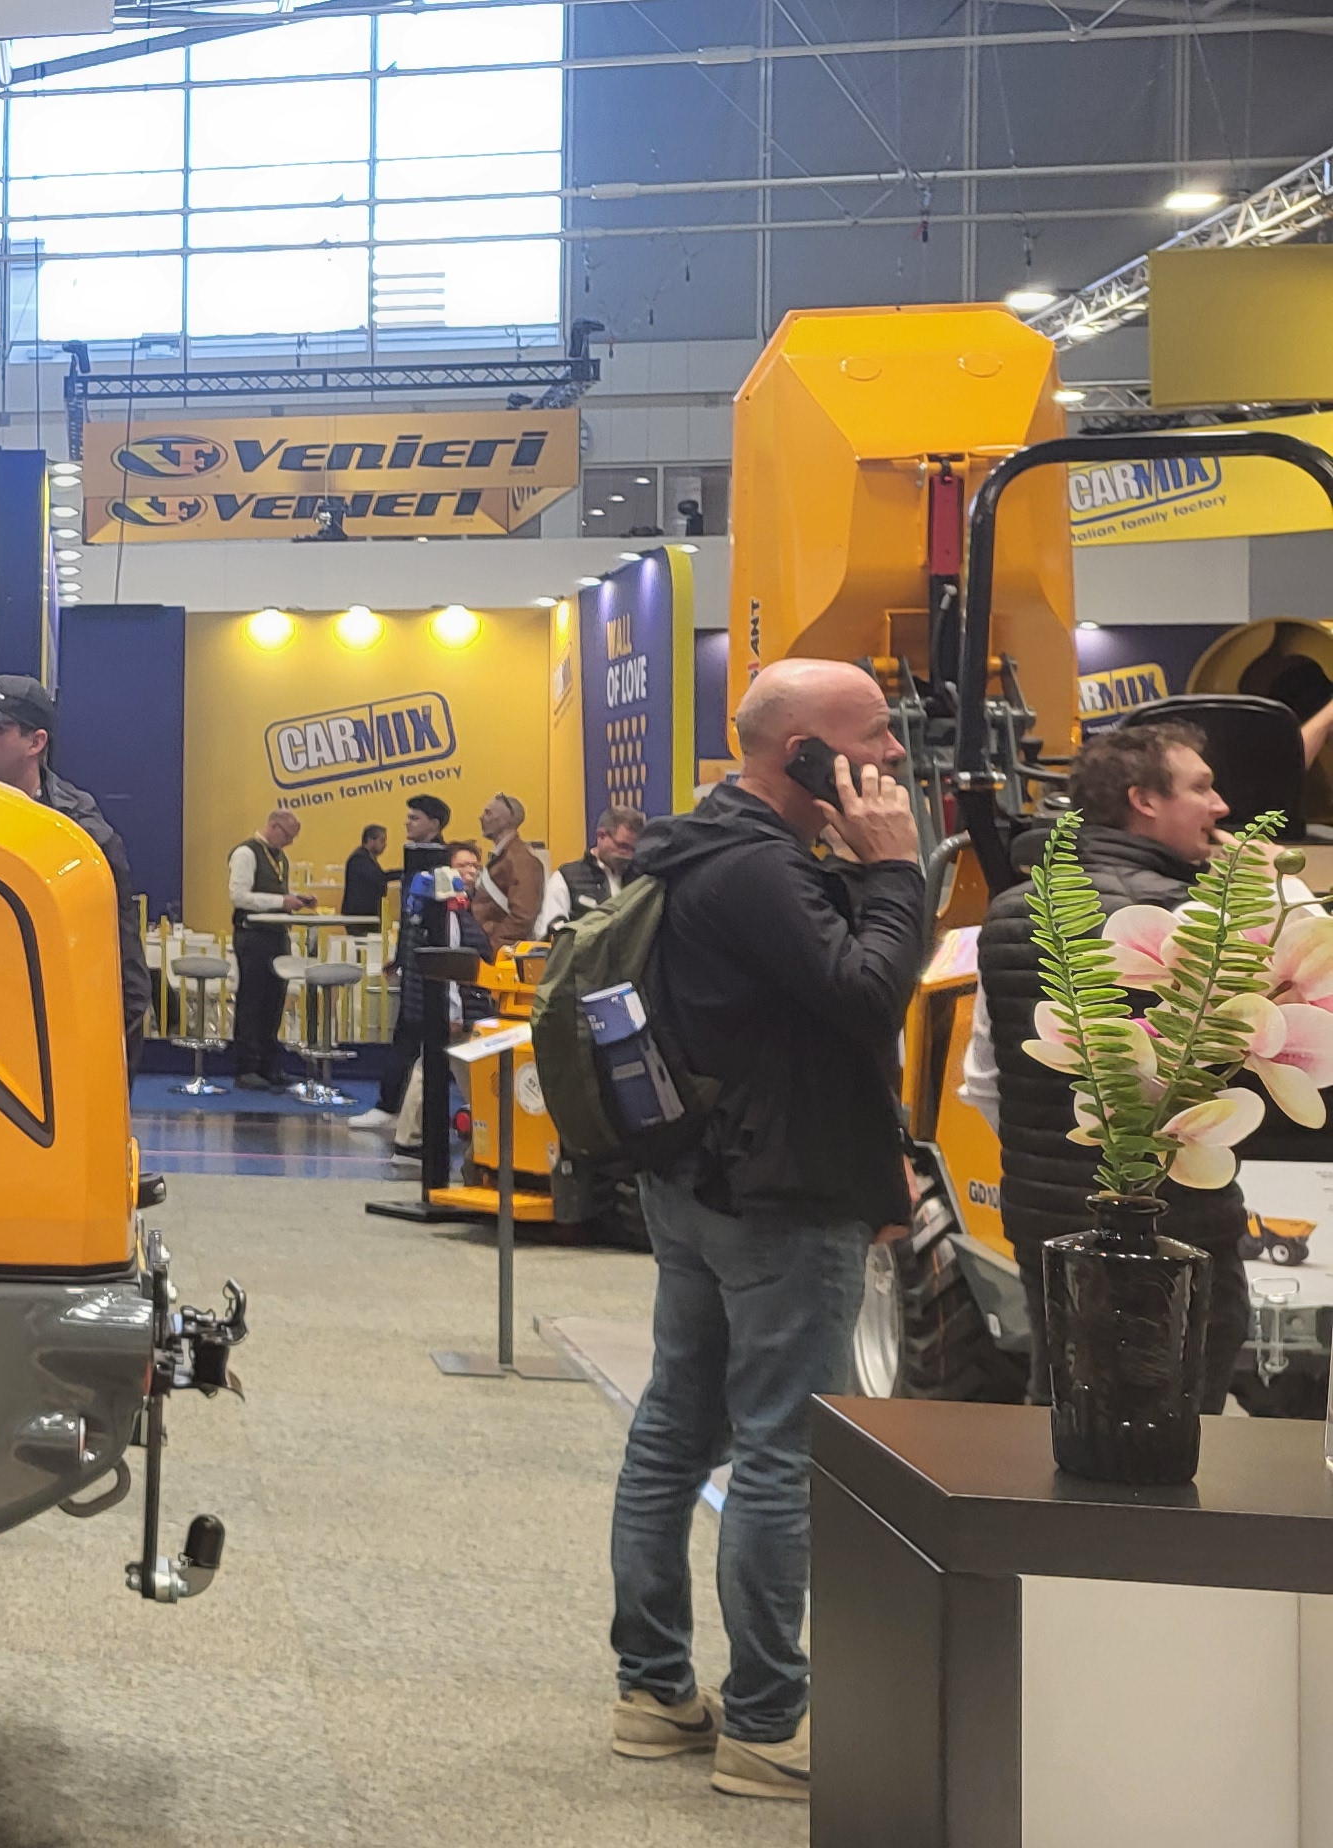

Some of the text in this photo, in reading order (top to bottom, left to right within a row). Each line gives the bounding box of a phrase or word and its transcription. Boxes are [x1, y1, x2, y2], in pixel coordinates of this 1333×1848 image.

[1069, 457, 1210, 513] CARMIX
[1121, 510, 1168, 531] family
[1173, 494, 1228, 517] factory
[606, 664, 620, 709] OF
[621, 654, 648, 705] LOVE
[277, 704, 443, 774] CARMIX
[277, 764, 463, 810] Italian family factory
